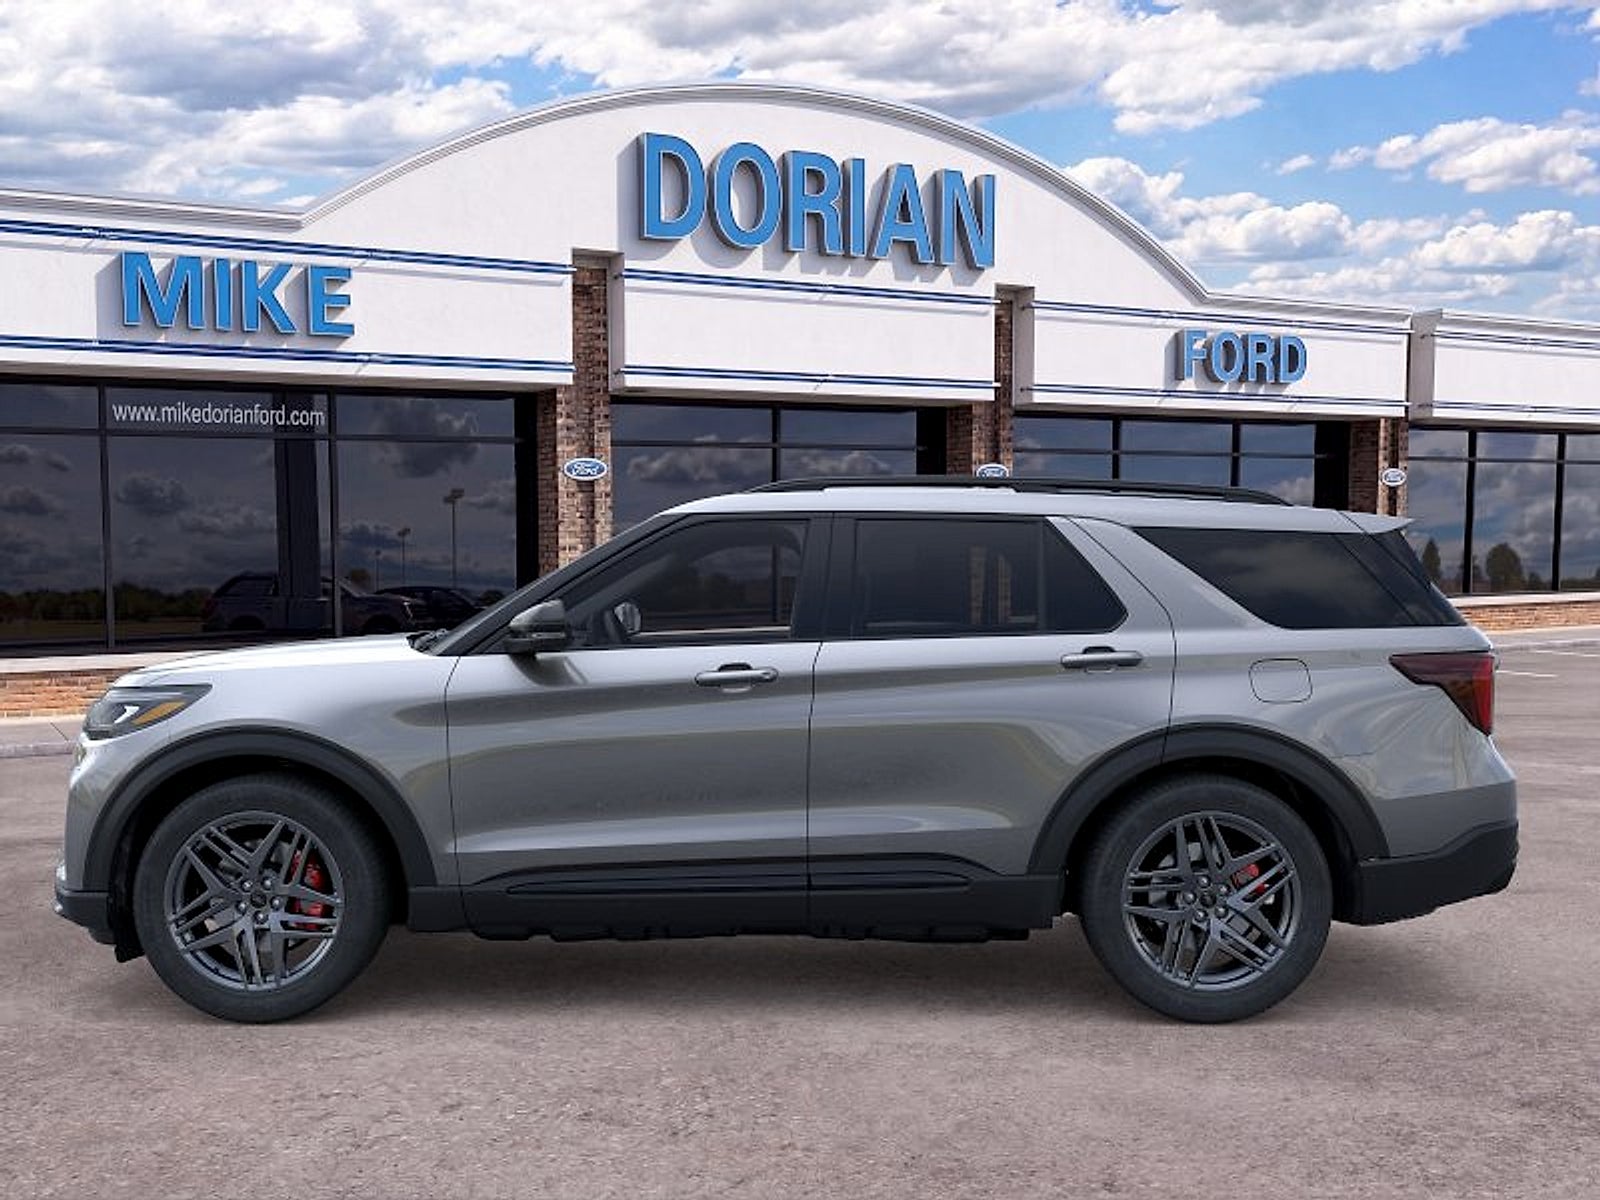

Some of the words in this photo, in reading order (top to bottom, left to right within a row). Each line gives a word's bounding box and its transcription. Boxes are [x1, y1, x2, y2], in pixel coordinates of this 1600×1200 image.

[641, 132, 996, 269] DORIAN
[121, 251, 355, 337] MIKE
[1177, 329, 1308, 384] FORD
[112, 402, 326, 426] www.mikedorianford.com
